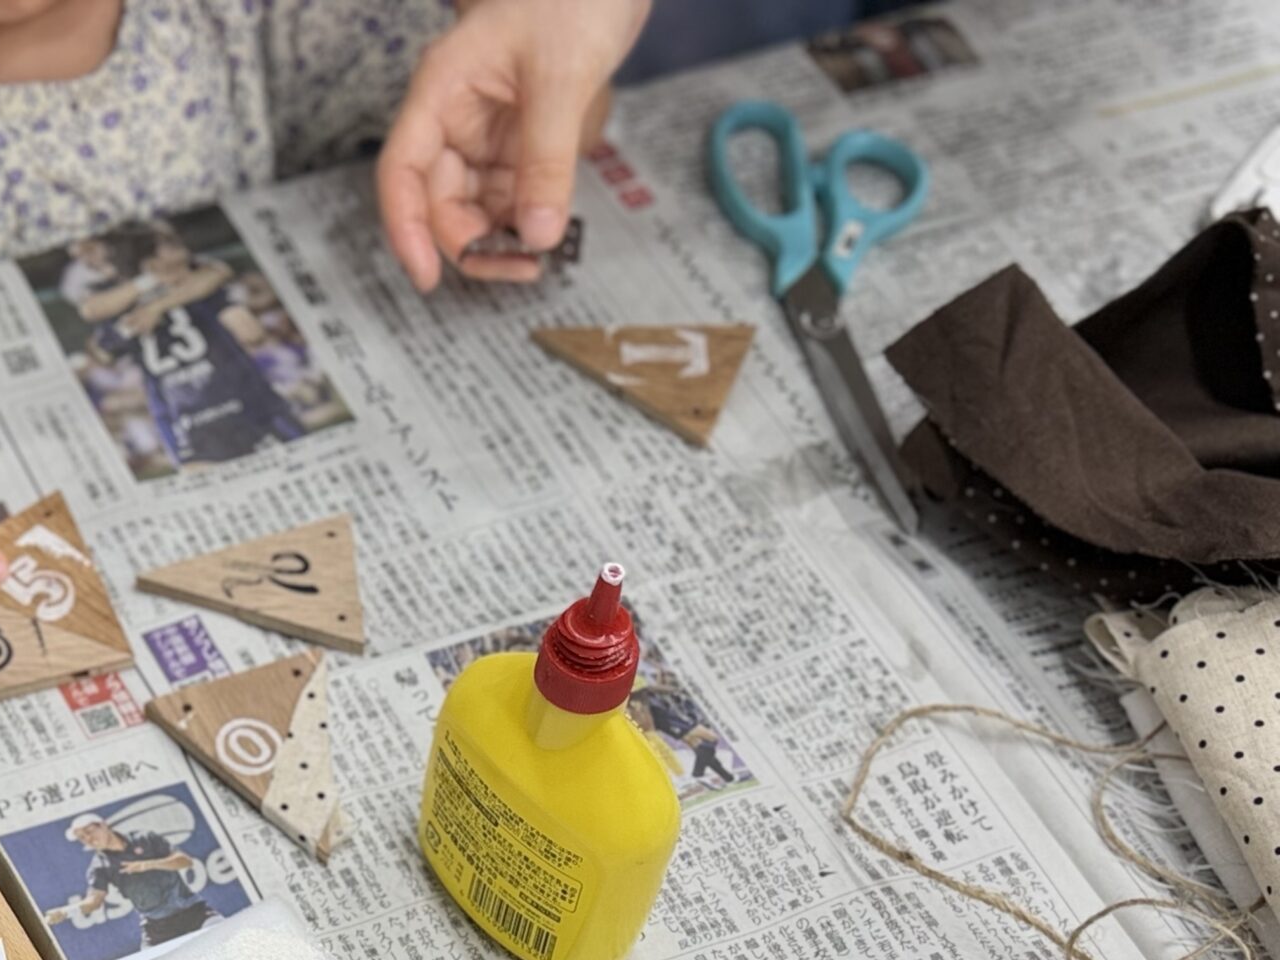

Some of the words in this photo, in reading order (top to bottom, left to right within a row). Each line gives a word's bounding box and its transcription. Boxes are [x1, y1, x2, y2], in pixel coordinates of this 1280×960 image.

[895, 757, 968, 847] 鳥取が逆転
